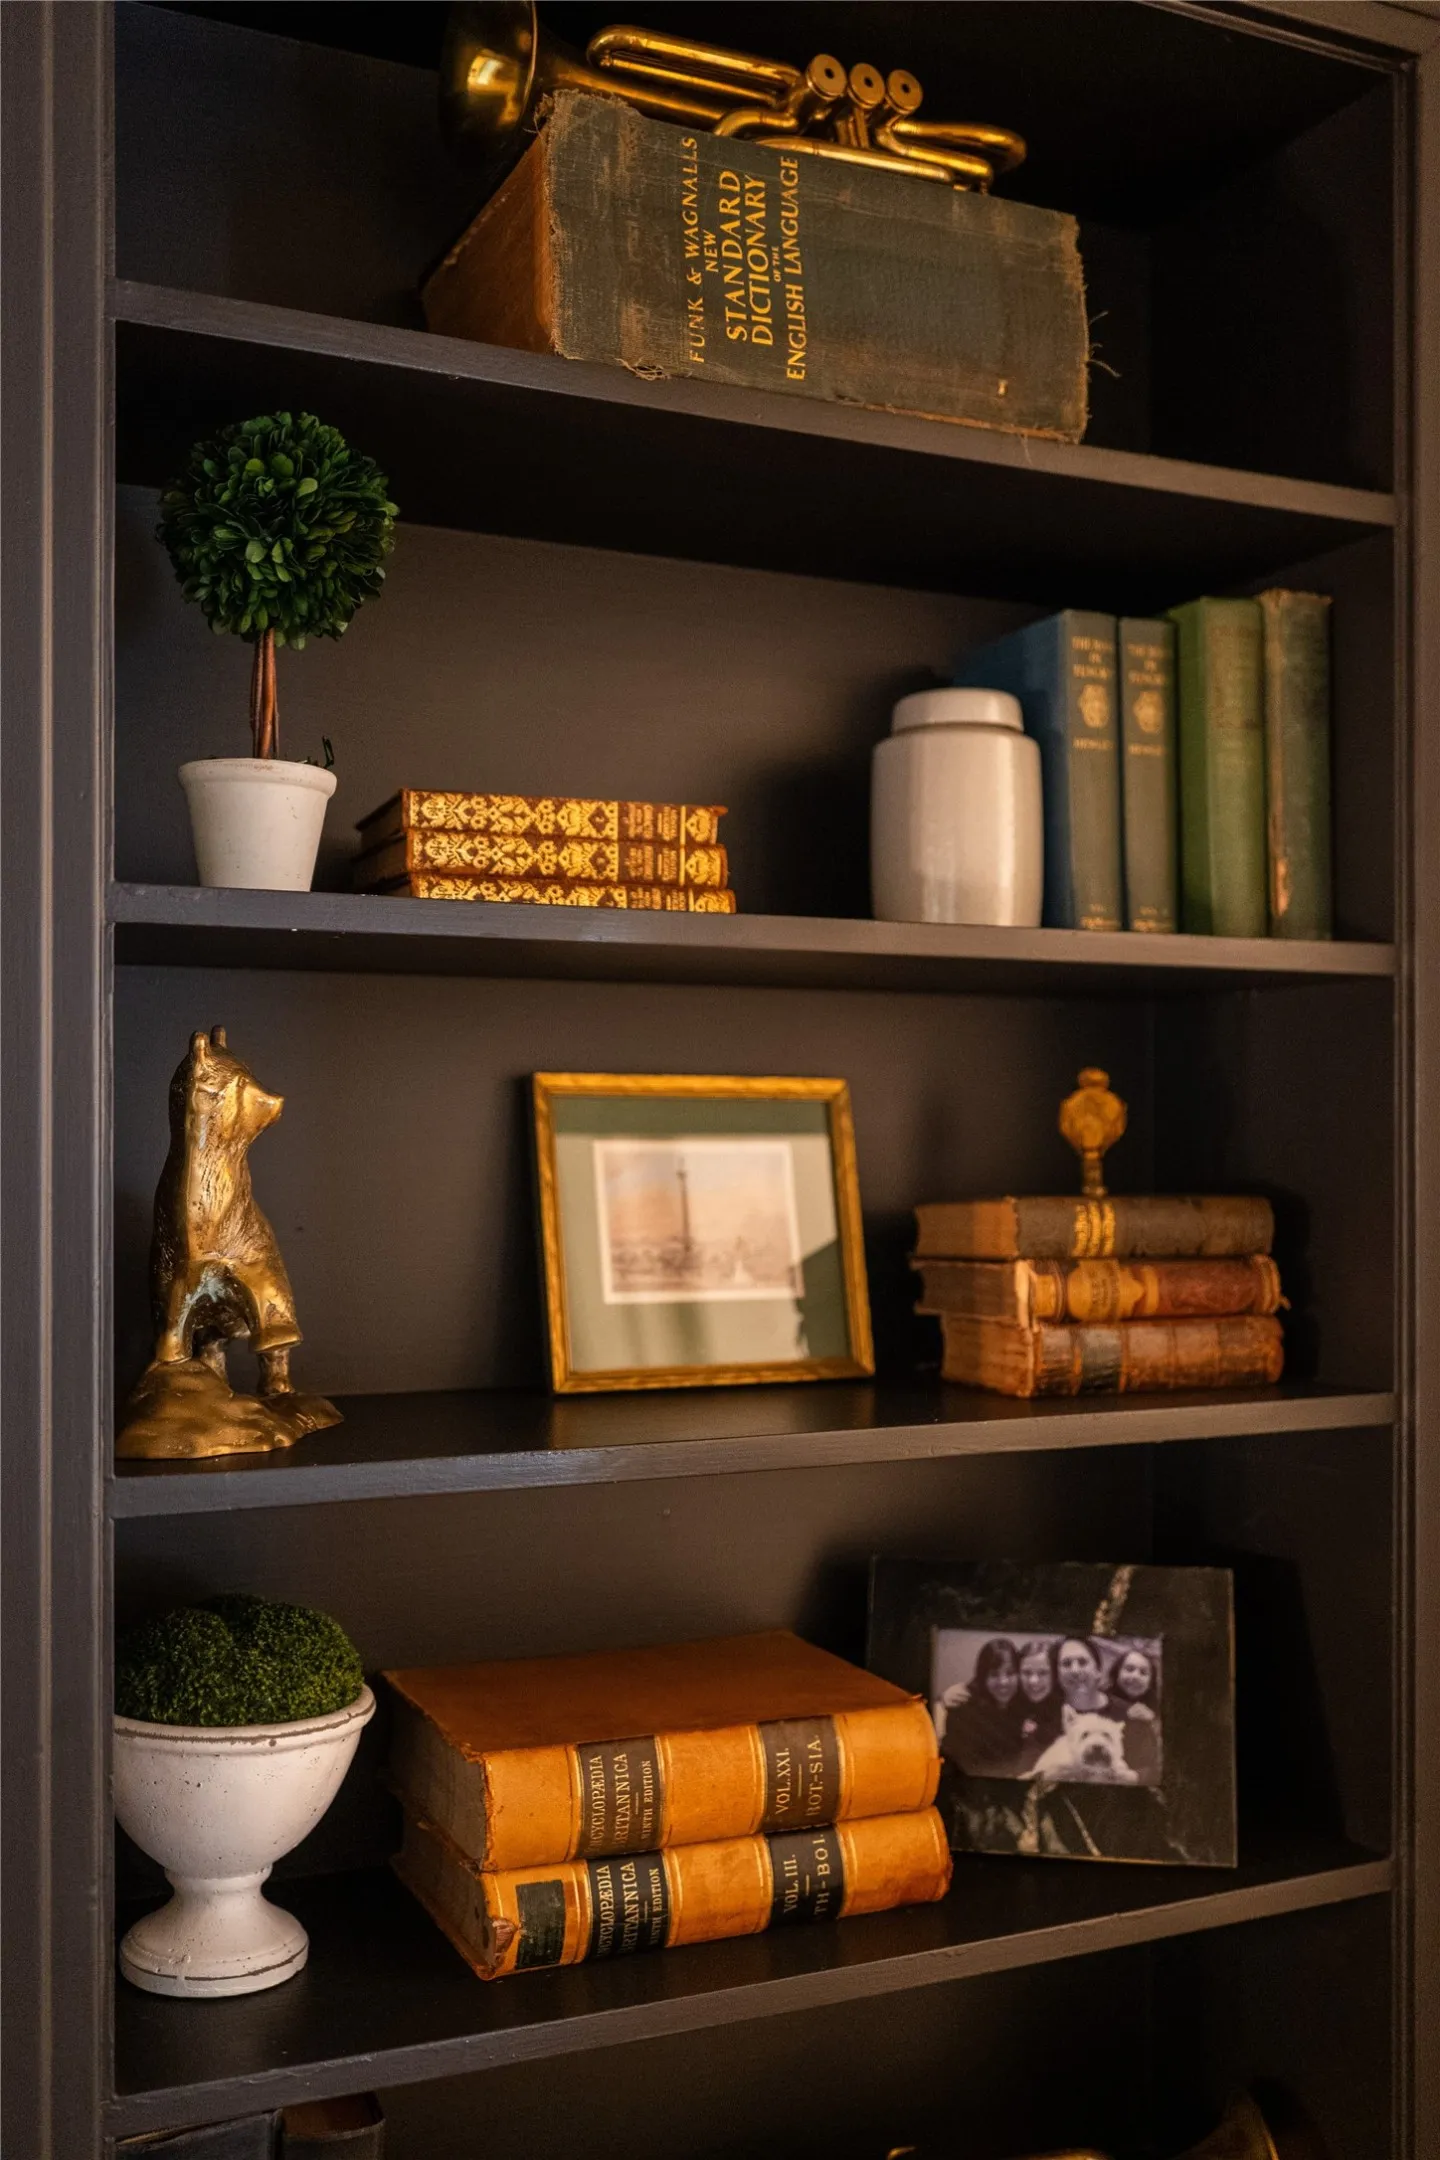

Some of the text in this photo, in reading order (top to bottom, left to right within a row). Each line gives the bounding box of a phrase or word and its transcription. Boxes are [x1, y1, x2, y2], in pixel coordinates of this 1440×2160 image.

[681, 138, 706, 364] FUNK & WAGNALLS
[703, 229, 719, 273] NEW
[719, 170, 747, 341] STANDARD
[744, 174, 773, 346] DICTIONARY
[772, 246, 781, 283] OF THE
[781, 156, 806, 381] ENGLISH LANGUAGE
[641, 1760, 653, 1803] EDITION
[595, 1865, 615, 1957] NCYCLOPÆDIA
[649, 1868, 662, 1912] EDITION
